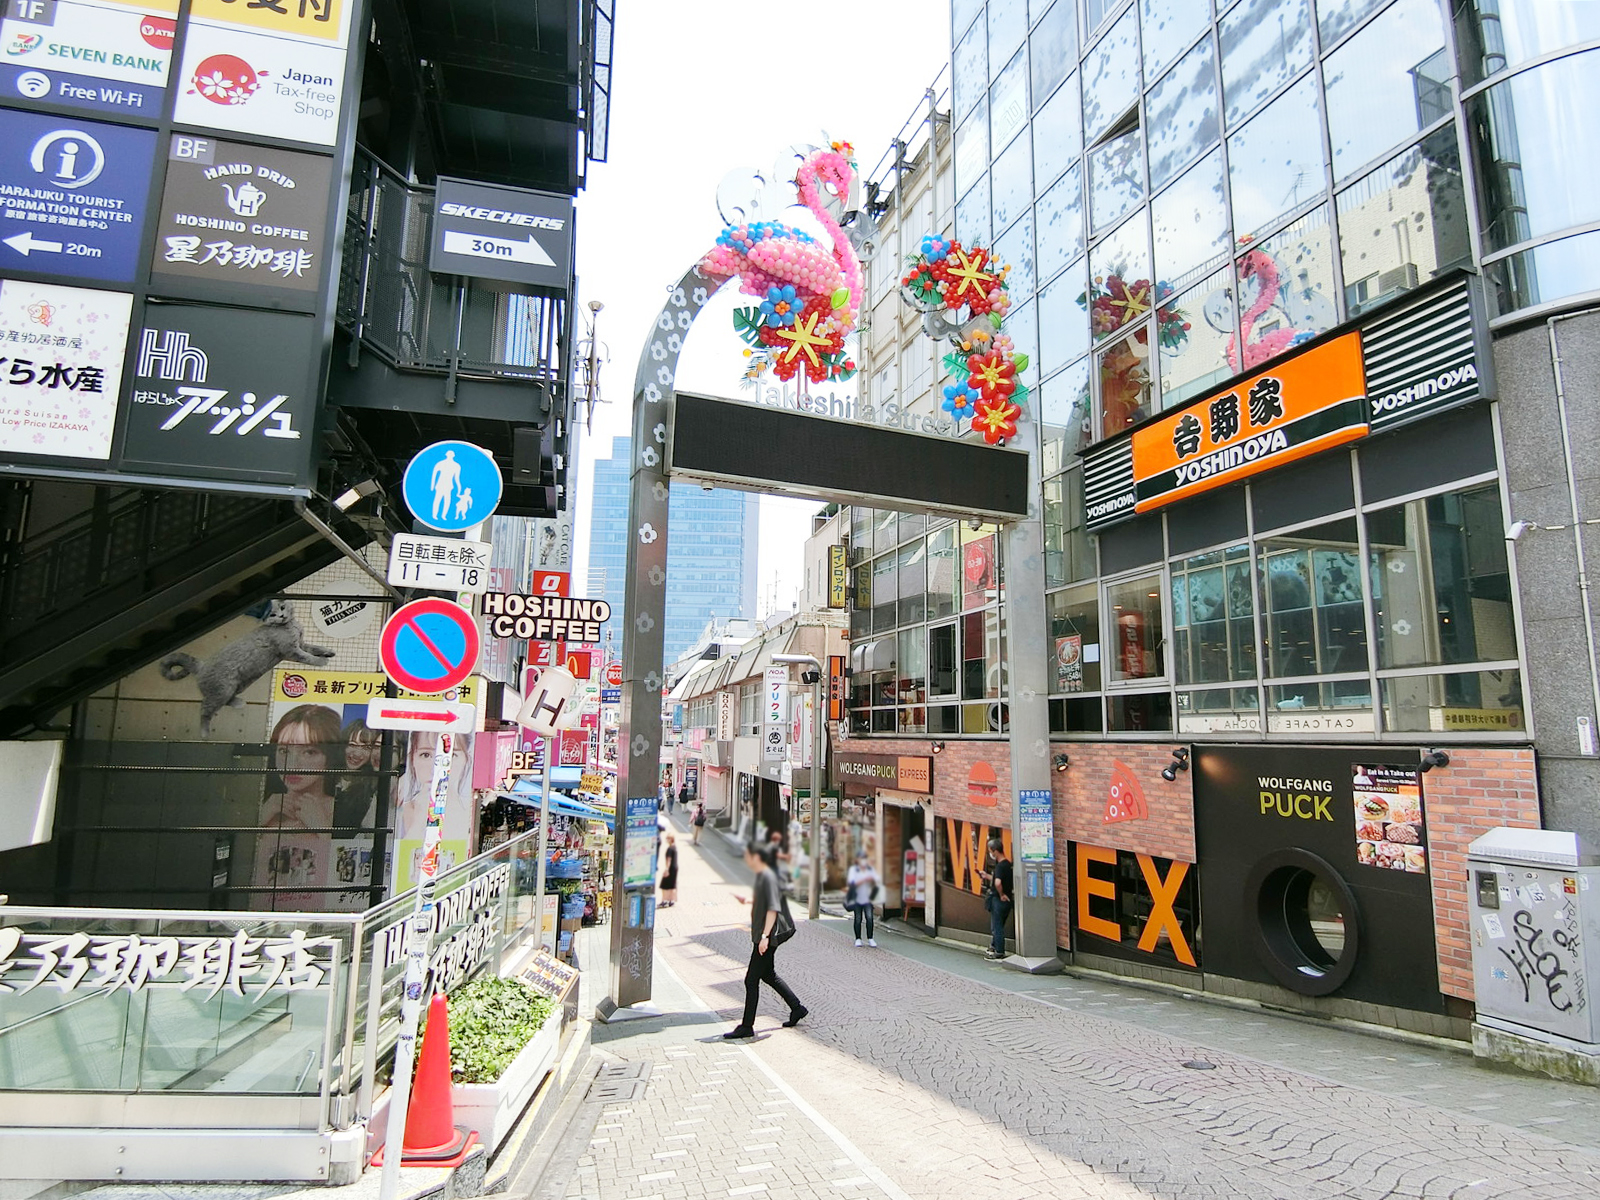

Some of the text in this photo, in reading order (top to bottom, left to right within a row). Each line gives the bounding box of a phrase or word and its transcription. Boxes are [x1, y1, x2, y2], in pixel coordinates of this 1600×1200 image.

[17, 0, 45, 20] 1F
[47, 43, 164, 73] SEVEN BANK
[282, 68, 334, 87] Japan
[59, 81, 144, 108] Free Wi-Fi
[273, 82, 336, 104] Tax-free
[294, 101, 334, 120] Shop
[176, 137, 208, 159] BF
[203, 164, 297, 190] HAND DRIP
[0, 184, 125, 210] HARAJUKU TOURIST
[5, 209, 27, 221] 原宿
[82, 208, 134, 223] CENTER
[175, 213, 310, 242] HOSHINO COFFEE
[439, 202, 566, 232] SKECHERS
[66, 243, 103, 258] 20m
[164, 236, 314, 279] 星乃珈琲
[472, 239, 514, 257] 30m
[134, 389, 185, 407] はらじゅく
[1370, 363, 1479, 416] YOSHINOYA
[24, 409, 69, 420] Suisan
[159, 386, 302, 440] アッシュ
[750, 377, 959, 439] Takeshita Street
[1172, 376, 1285, 460] 吉野家
[2, 418, 90, 433] Low Price IZAKAYA
[1174, 429, 1289, 488] YOSHINOYA
[1086, 493, 1136, 520] YOSHINOYA
[398, 540, 487, 567] 自転車を除く
[560, 524, 570, 566] CAT CAFE
[461, 568, 479, 587] 18
[832, 547, 844, 601] コインロッカー
[345, 604, 362, 617] WAY
[484, 593, 612, 622] HOSHINO
[494, 615, 600, 642] COFFEE
[530, 688, 567, 728] H
[771, 682, 781, 721] プリクラ
[512, 752, 537, 770] BF
[839, 761, 928, 781] WOLFGANG PUCK EXPRESS
[1389, 769, 1405, 777] Take
[1405, 770, 1417, 778] out
[1257, 776, 1334, 792] WOLFGANG
[1259, 791, 1335, 822] PUCK
[436, 886, 473, 934] DRIP
[471, 862, 512, 912] COFFEE
[1076, 841, 1199, 968] EX
